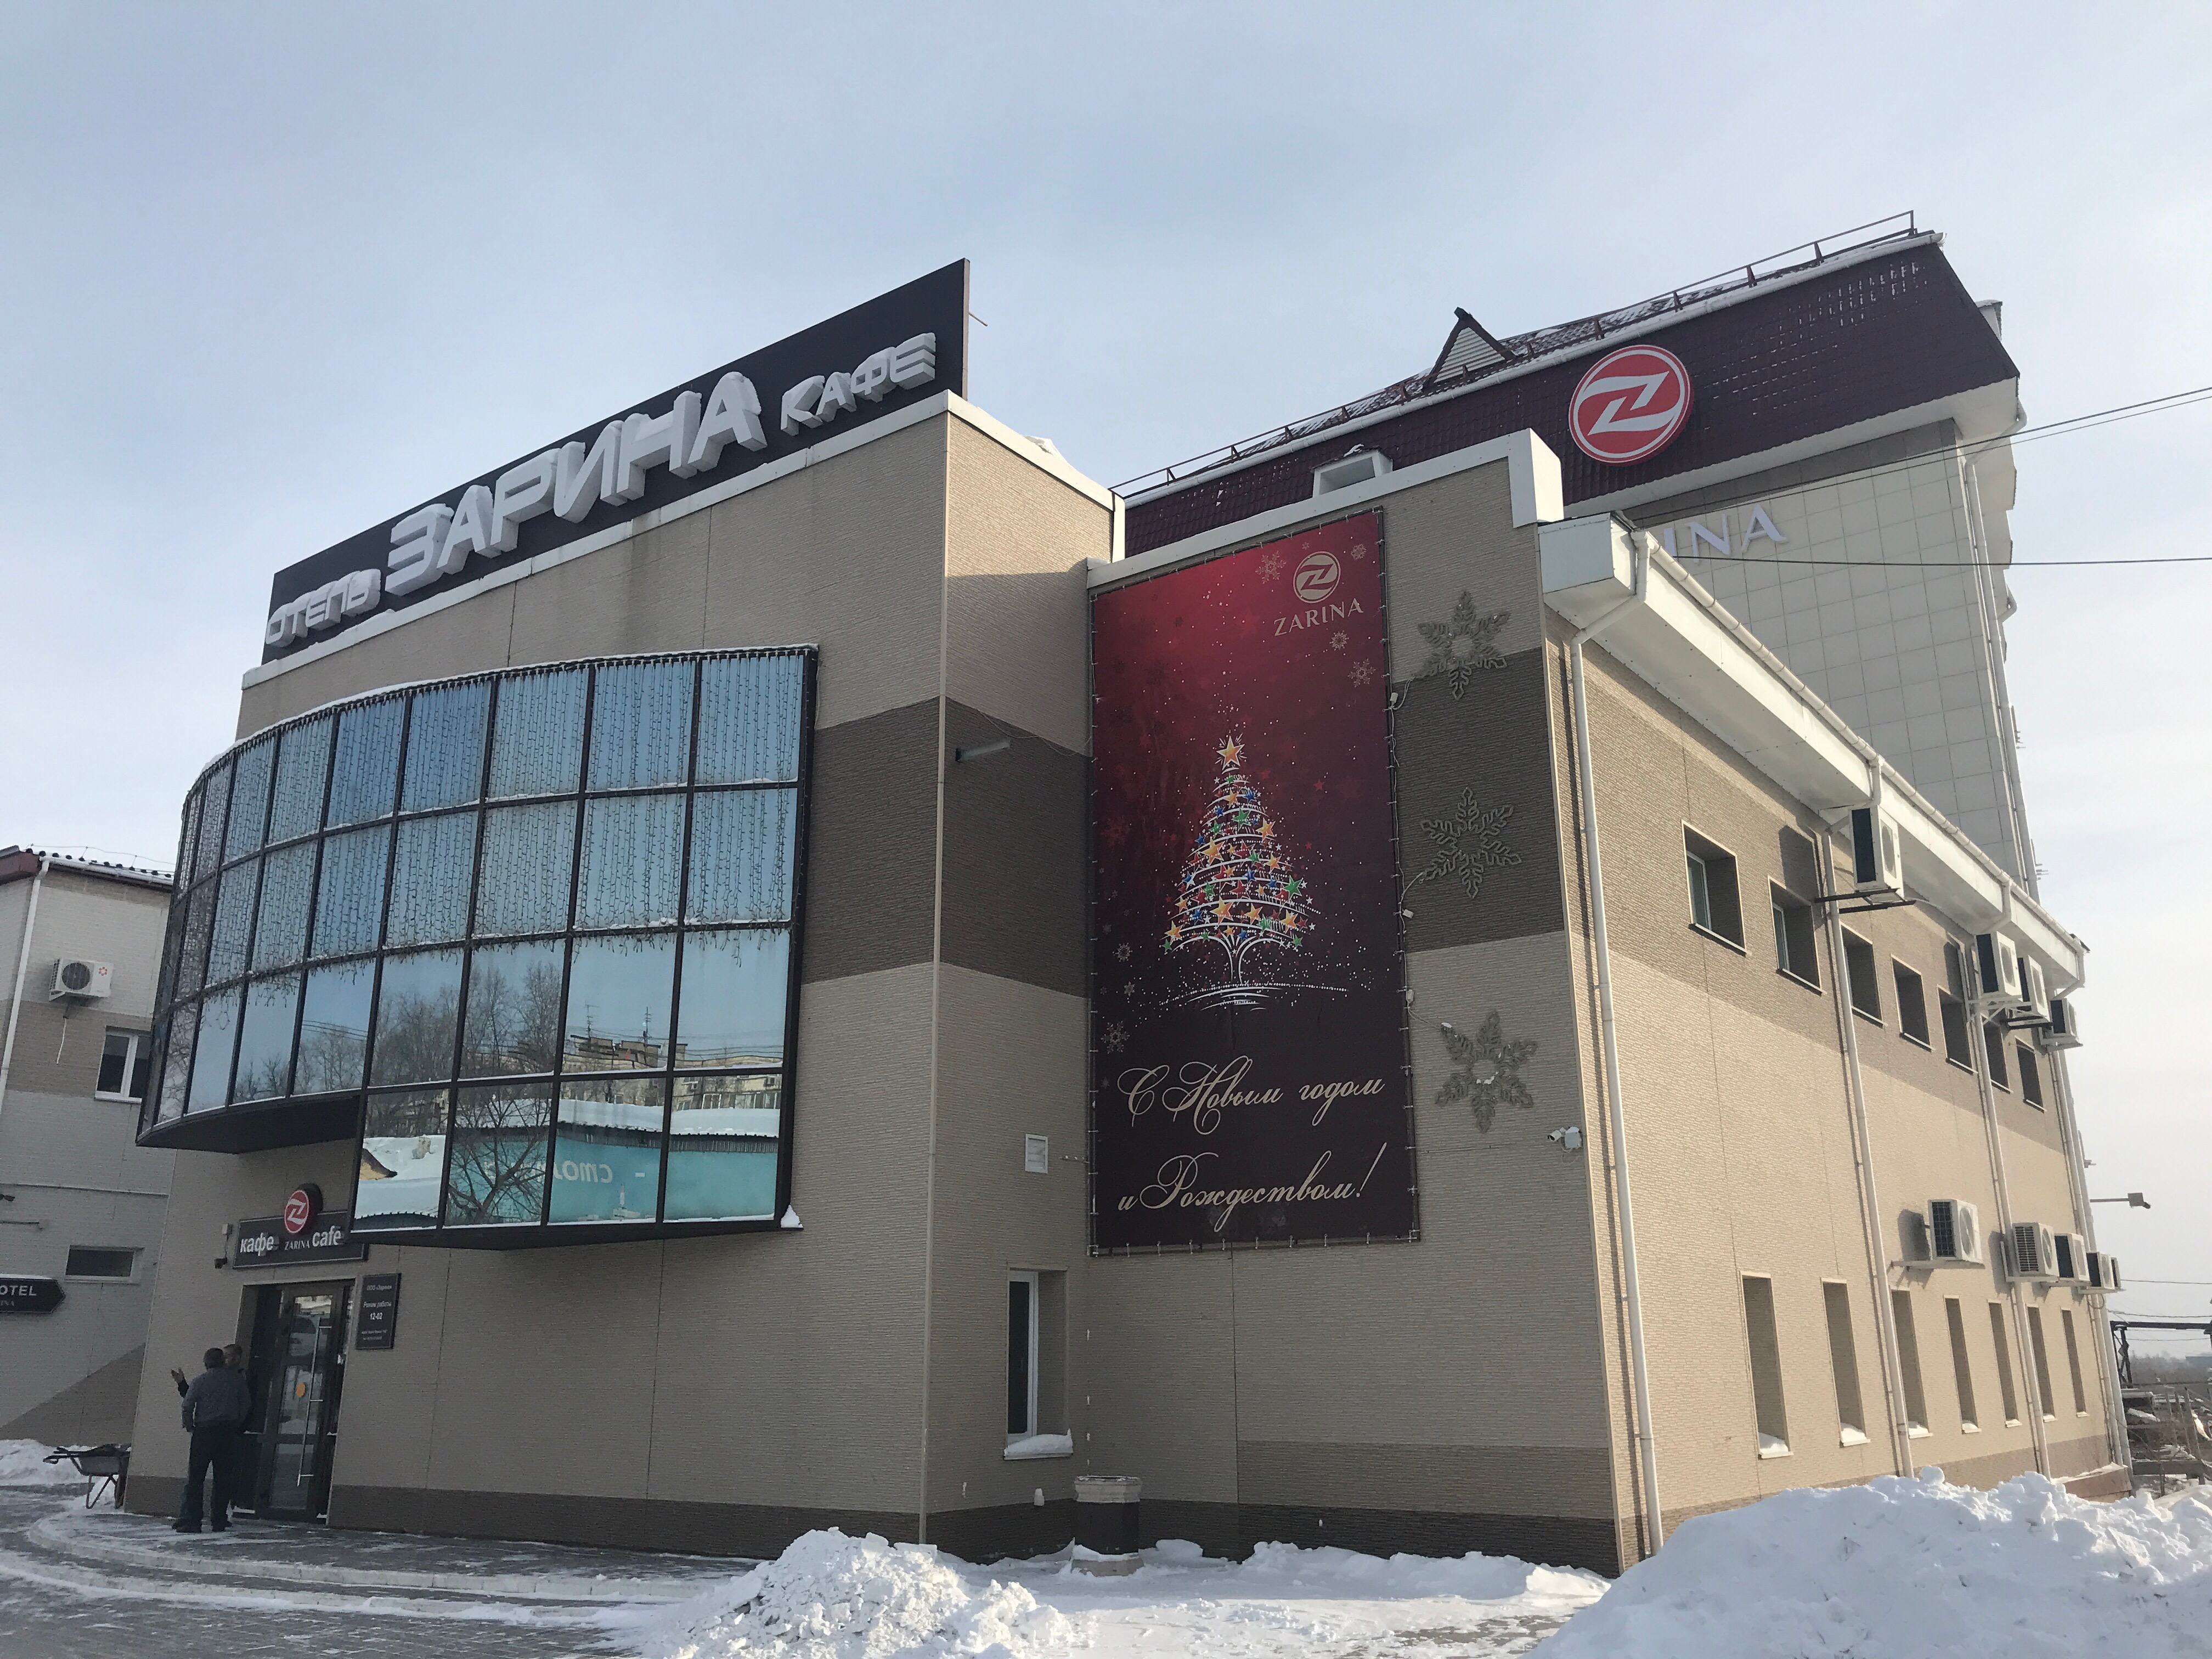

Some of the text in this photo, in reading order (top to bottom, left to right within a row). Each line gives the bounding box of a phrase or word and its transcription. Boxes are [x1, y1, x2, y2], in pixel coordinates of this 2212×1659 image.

[266, 332, 936, 647] ОТЕЛЬ ЗАРИНА КАФЕ
[1274, 598, 1364, 636] ZARINA
[1162, 1055, 1284, 1135] Новым
[1298, 1078, 1386, 1126] годом
[1118, 1142, 1387, 1232] и Рождеством!
[240, 1232, 275, 1256] кафе
[284, 1239, 311, 1251] ZARINA
